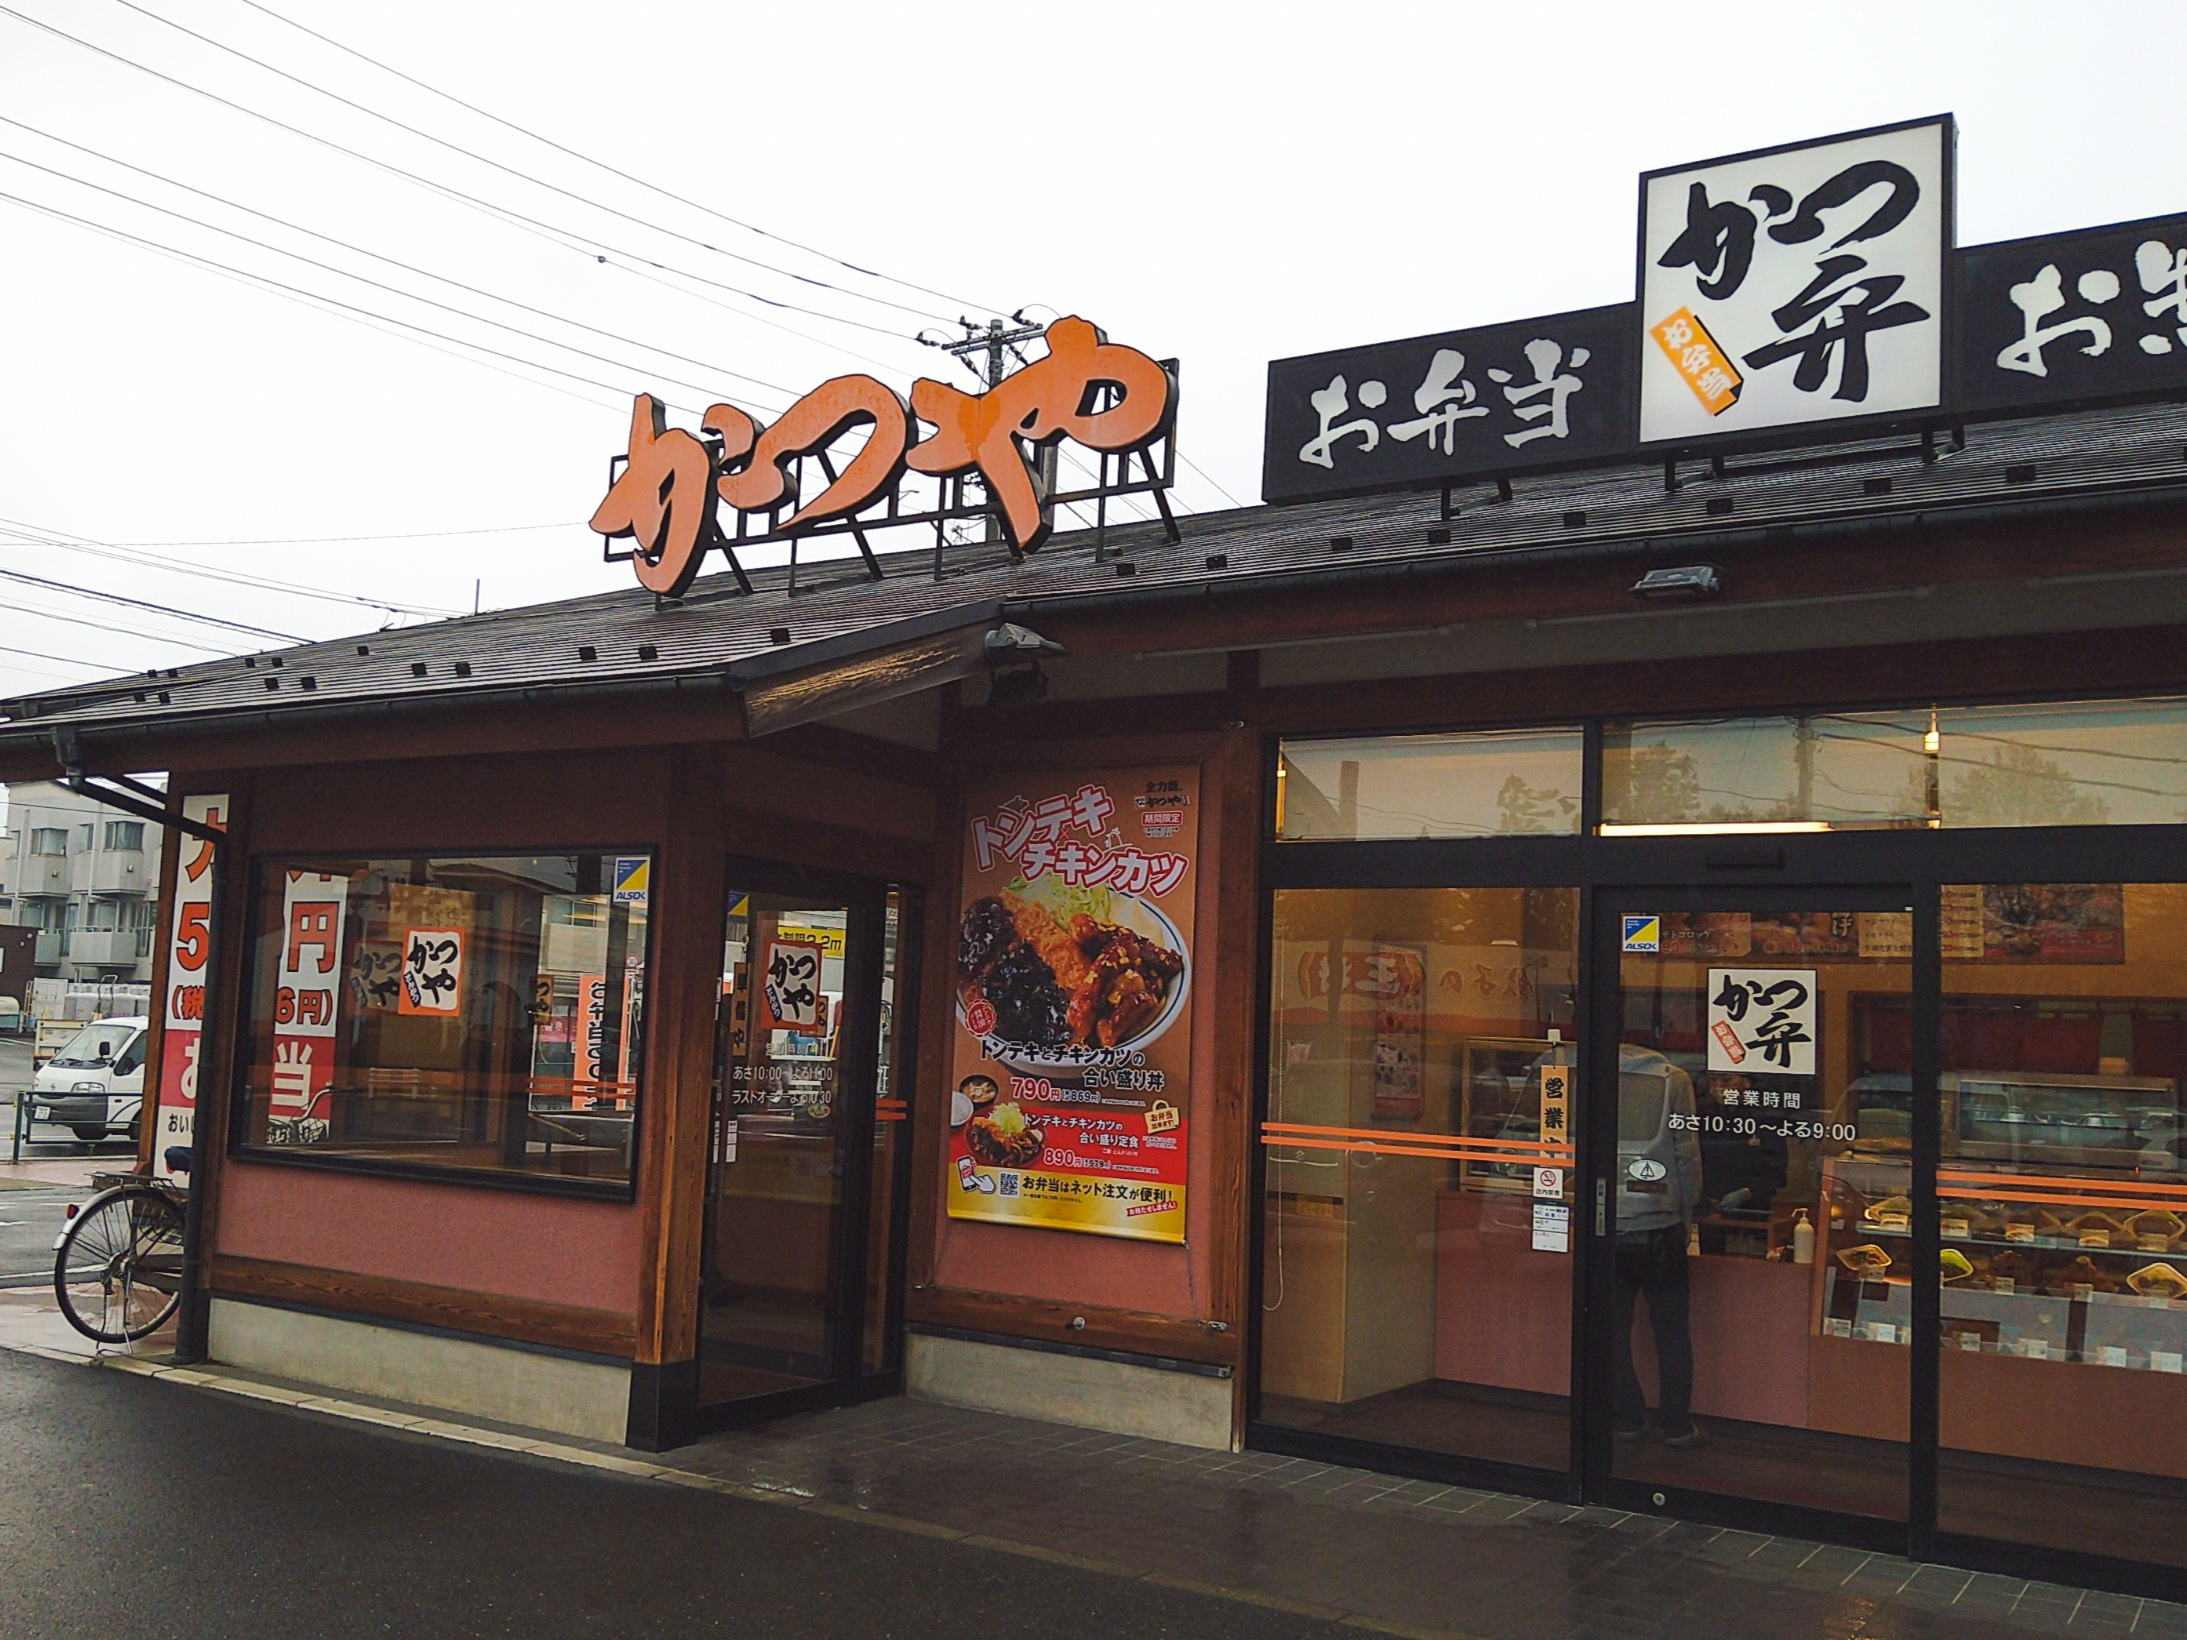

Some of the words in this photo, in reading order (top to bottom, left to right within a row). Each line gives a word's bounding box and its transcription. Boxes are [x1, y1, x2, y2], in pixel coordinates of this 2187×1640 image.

[1298, 338, 1591, 469] お弁当
[589, 315, 1168, 597] かつや
[972, 784, 1114, 871] トンテキ
[1144, 813, 1180, 825] 期間限定
[1020, 840, 1190, 898] チキンカツ
[616, 891, 646, 900] ALSOK
[287, 902, 340, 973] 円
[980, 1039, 1146, 1067] トンテキとチキンカツの
[271, 1041, 313, 1110] 当
[1083, 1067, 1165, 1091] 合い盛り丼
[1723, 1089, 1800, 1109] 営業時間
[1024, 1113, 1123, 1131] トンテキとチキンカツの
[1079, 1132, 1139, 1149] 合い盛り定食
